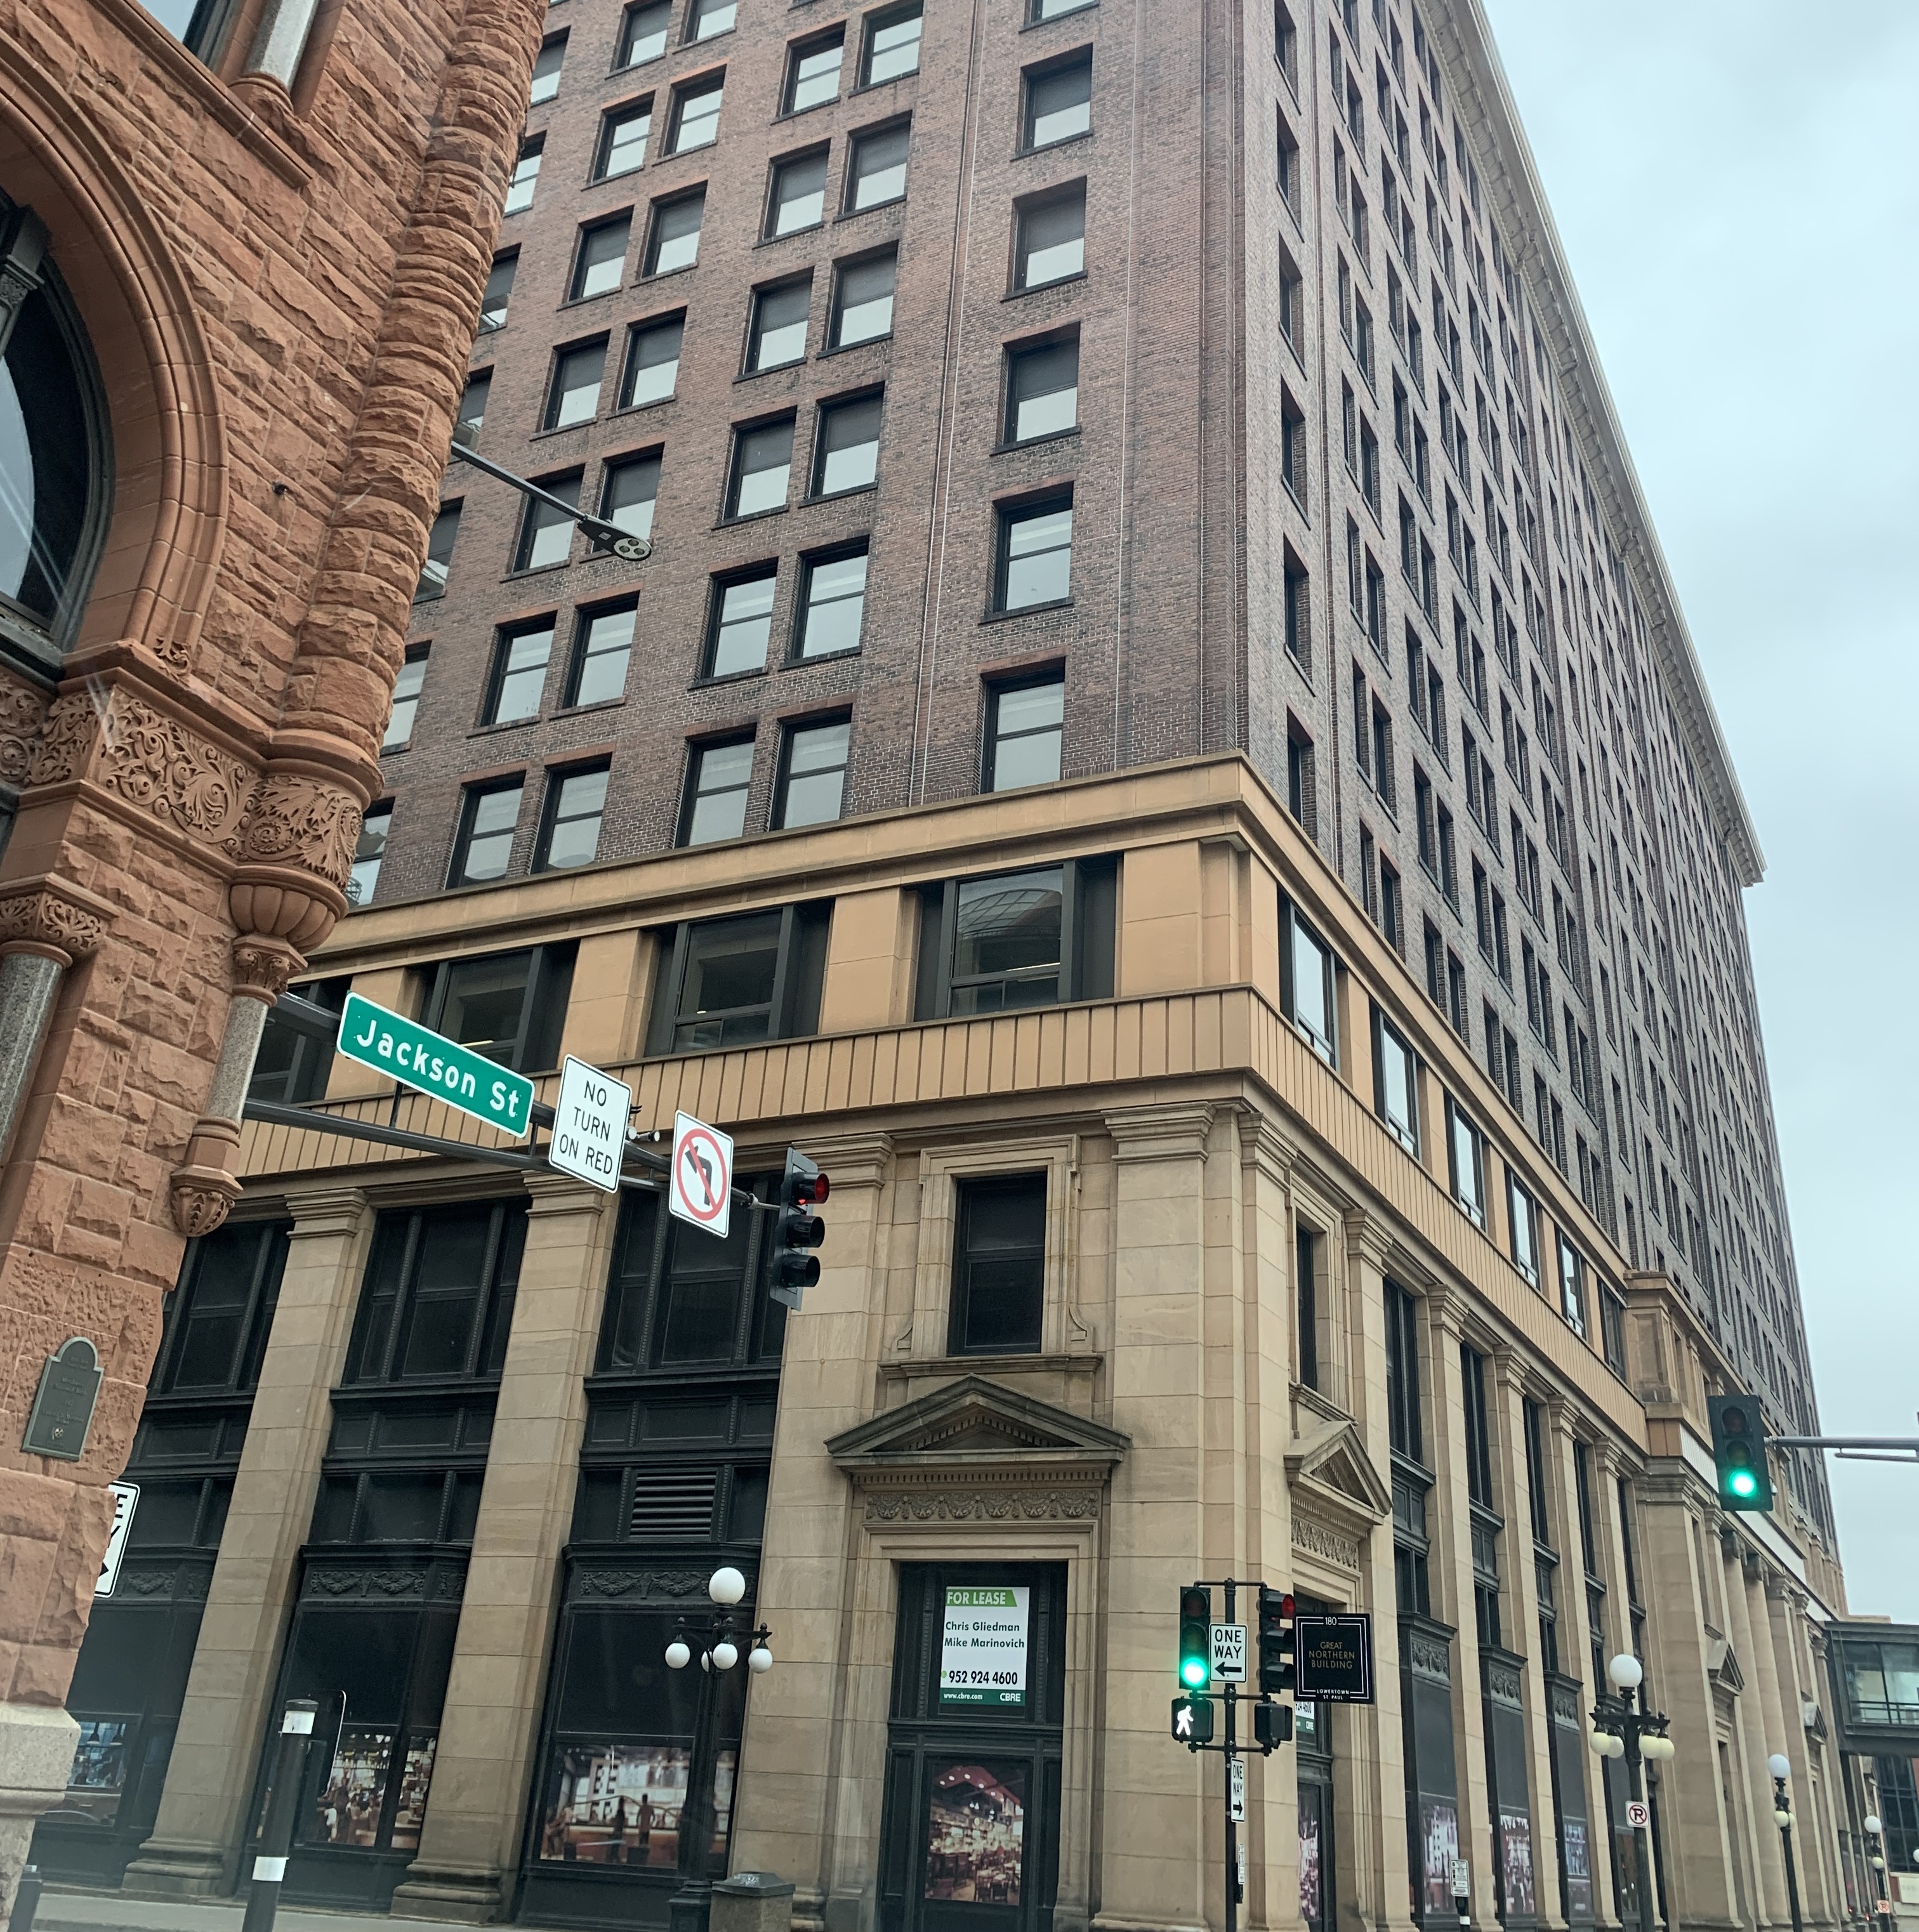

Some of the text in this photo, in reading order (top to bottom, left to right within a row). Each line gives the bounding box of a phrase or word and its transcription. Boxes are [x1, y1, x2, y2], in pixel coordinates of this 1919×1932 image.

[357, 1020, 518, 1117] Jackson St
[584, 1080, 607, 1107] NO
[574, 1106, 610, 1142] TURN
[560, 1134, 612, 1174] ON RED
[947, 1592, 1006, 1605] FOR LEASE
[946, 1621, 1020, 1631] Chris Gliedman
[1325, 1617, 1337, 1626] 180
[944, 1638, 1024, 1648] Mike Marinovich
[1215, 1629, 1242, 1643] ONE
[1215, 1645, 1242, 1659] WAY
[1309, 1650, 1355, 1659] NORTHERN
[1311, 1660, 1352, 1669] BUILDING
[949, 1671, 1018, 1685] 952 924 4600
[999, 1693, 1021, 1702] CBRE
[1233, 1764, 1243, 1779] ONE
[1233, 1782, 1243, 1796] WAY
